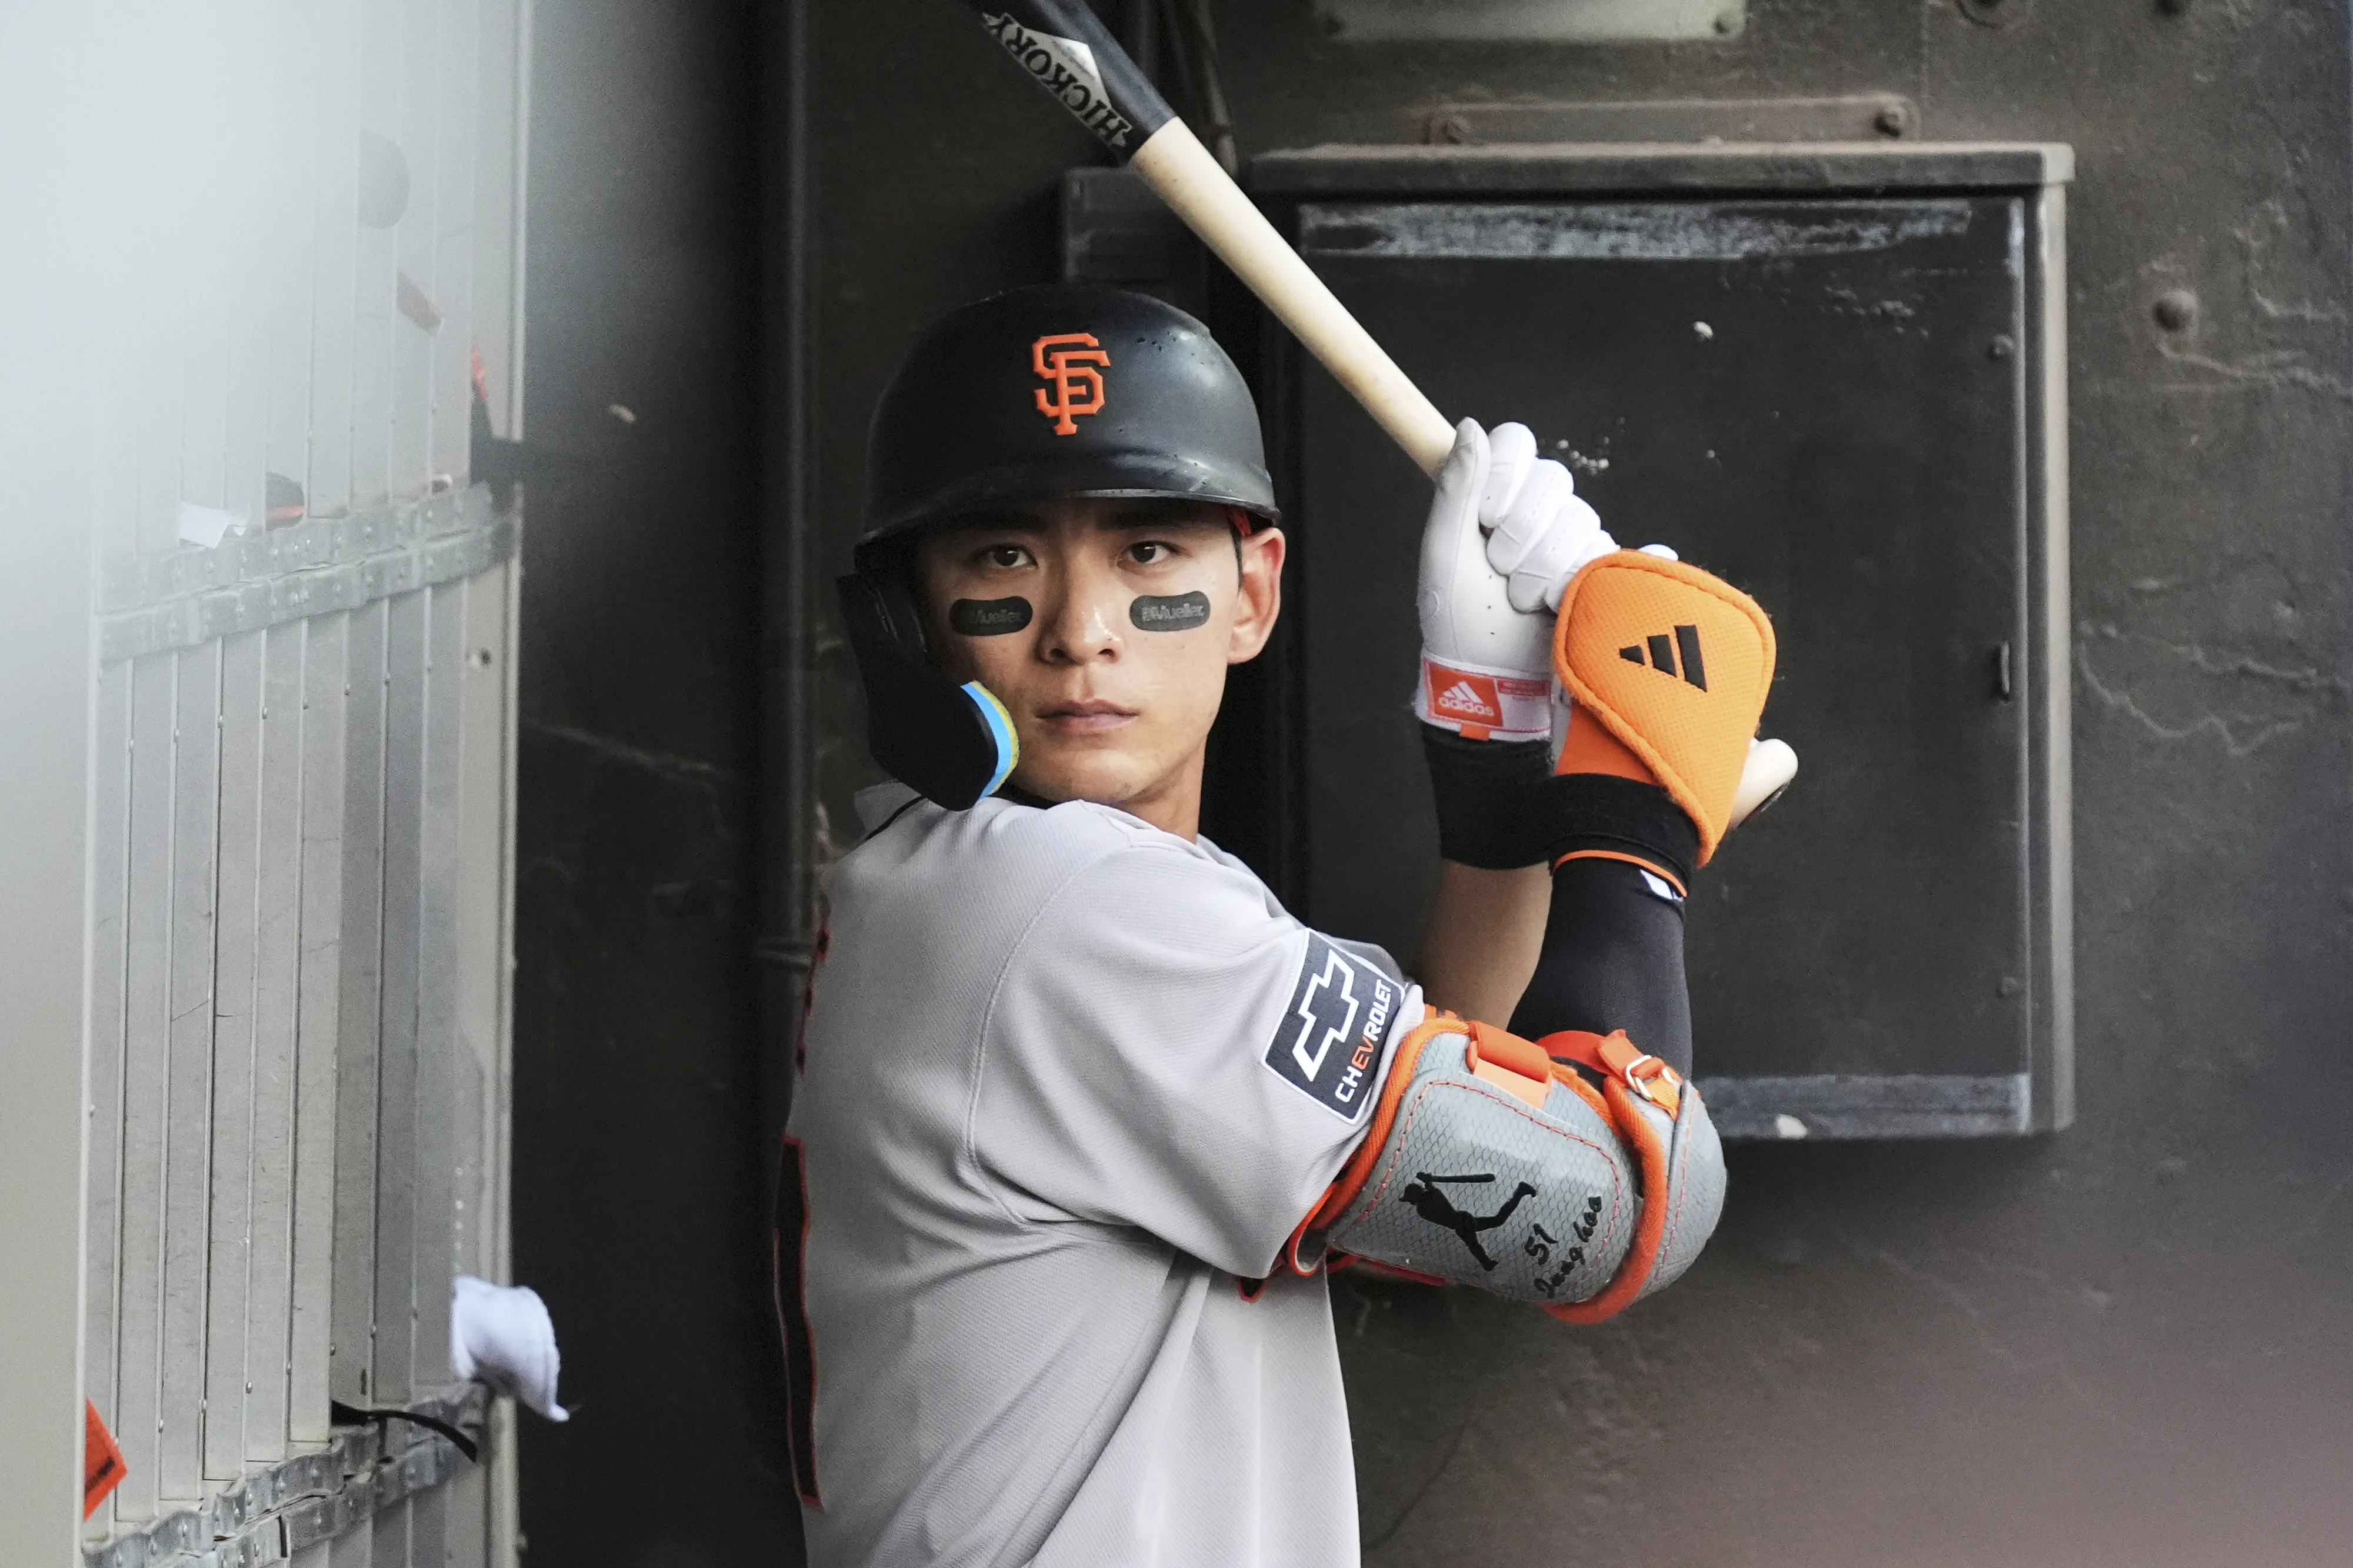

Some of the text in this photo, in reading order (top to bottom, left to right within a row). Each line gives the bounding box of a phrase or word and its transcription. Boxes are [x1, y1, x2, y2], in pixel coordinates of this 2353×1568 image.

[988, 16, 1129, 141] HICKORY
[1031, 332, 1111, 436] SF
[1437, 696, 1495, 717] adidas
[1334, 979, 1391, 1103] CHEVROLET
[1524, 1223, 1558, 1266] 51
